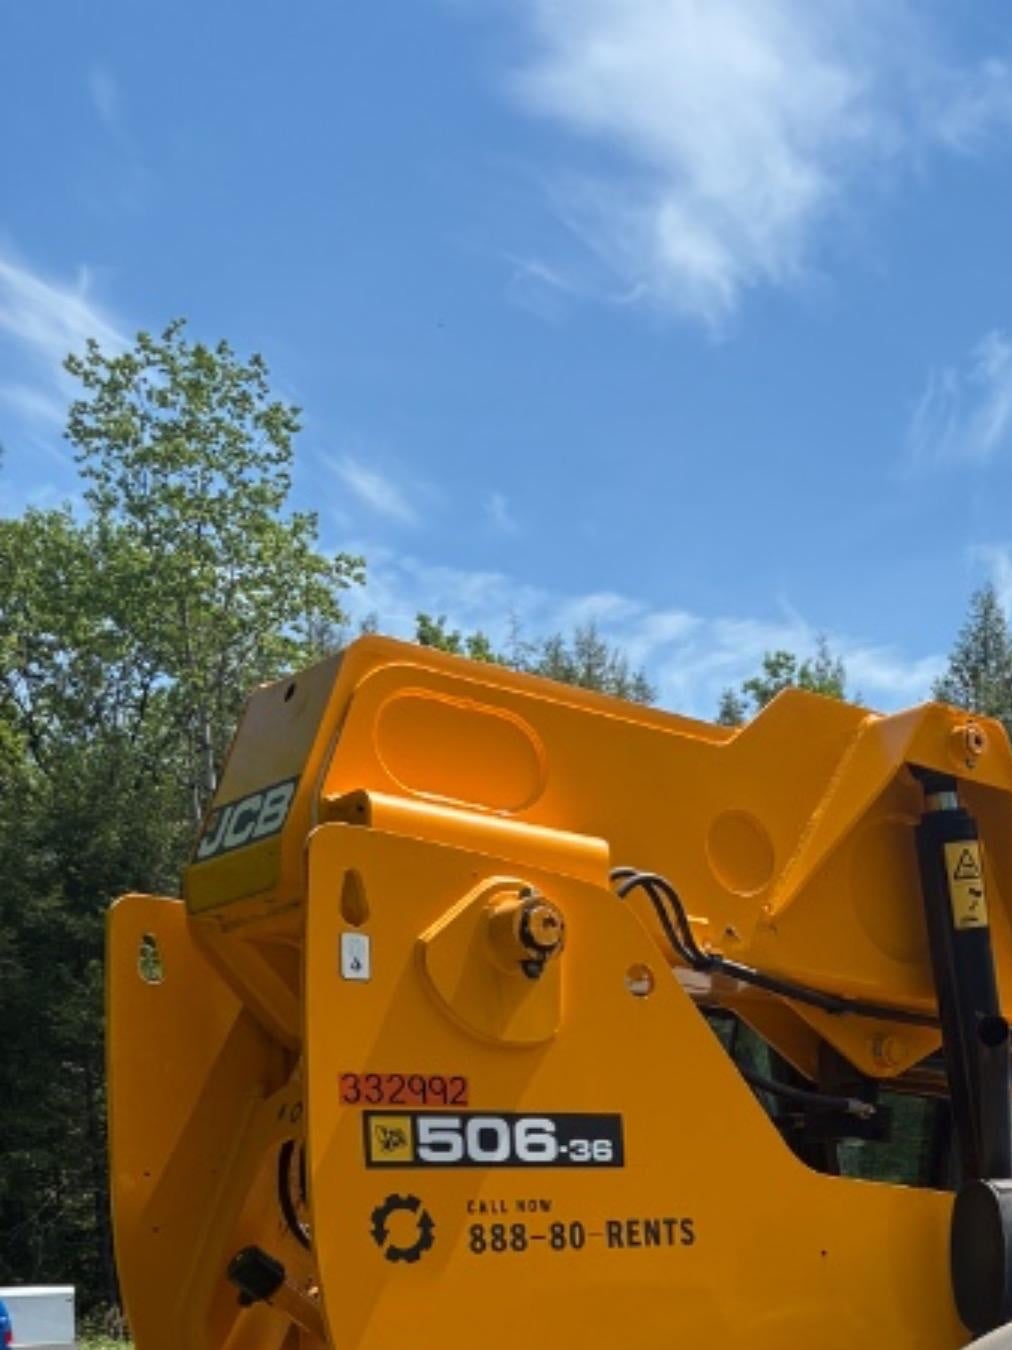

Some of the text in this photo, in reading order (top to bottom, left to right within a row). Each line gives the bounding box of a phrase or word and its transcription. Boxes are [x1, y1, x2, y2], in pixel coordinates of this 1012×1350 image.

[197, 782, 295, 858] JCB
[340, 1073, 468, 1106] 332992
[467, 1199, 551, 1215] CALL NOW
[469, 1218, 696, 1254] 888-80-RENTS
